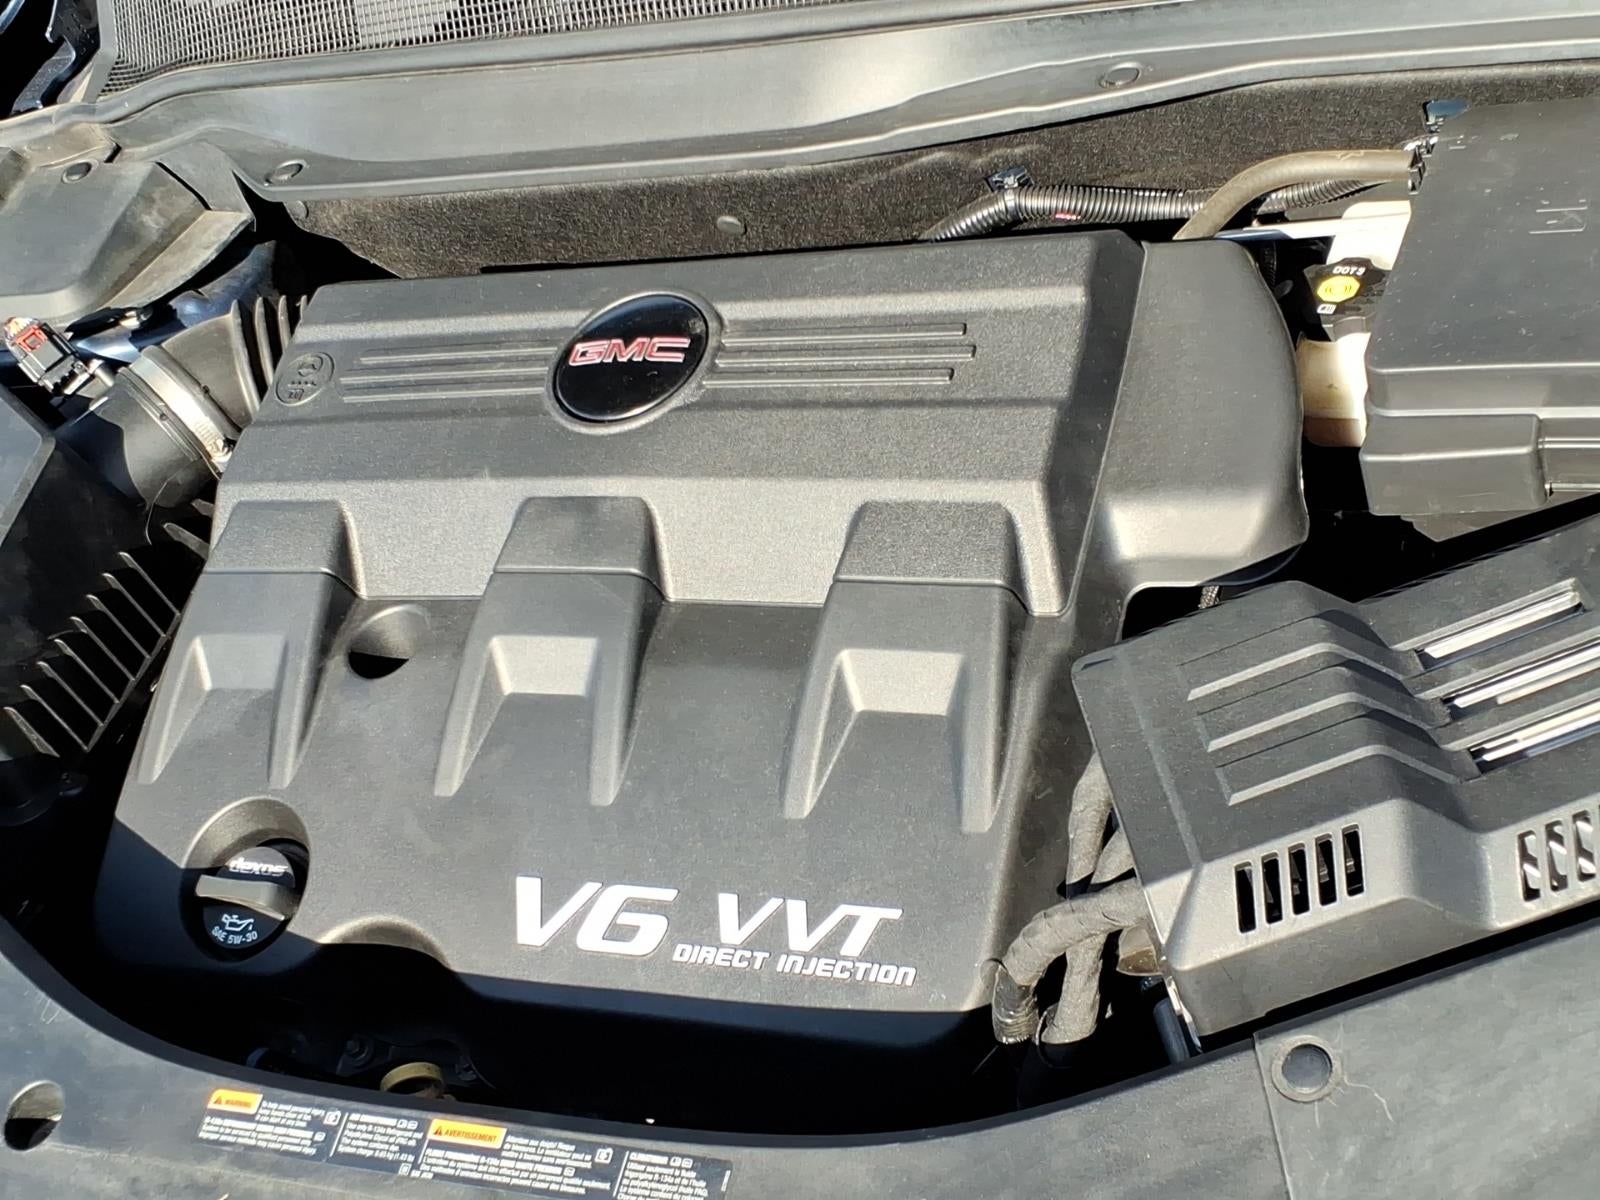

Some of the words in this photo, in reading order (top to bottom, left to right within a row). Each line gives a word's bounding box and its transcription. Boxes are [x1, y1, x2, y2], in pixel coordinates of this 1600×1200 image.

[569, 337, 691, 366] GMC
[516, 875, 679, 957] V6
[718, 892, 903, 958] VVT
[211, 926, 228, 942] SAE
[227, 931, 258, 945] 5W-30
[672, 943, 771, 971] DIRECT
[776, 952, 917, 986] INJECTION
[444, 1129, 497, 1142] AVERTISSEMENT
